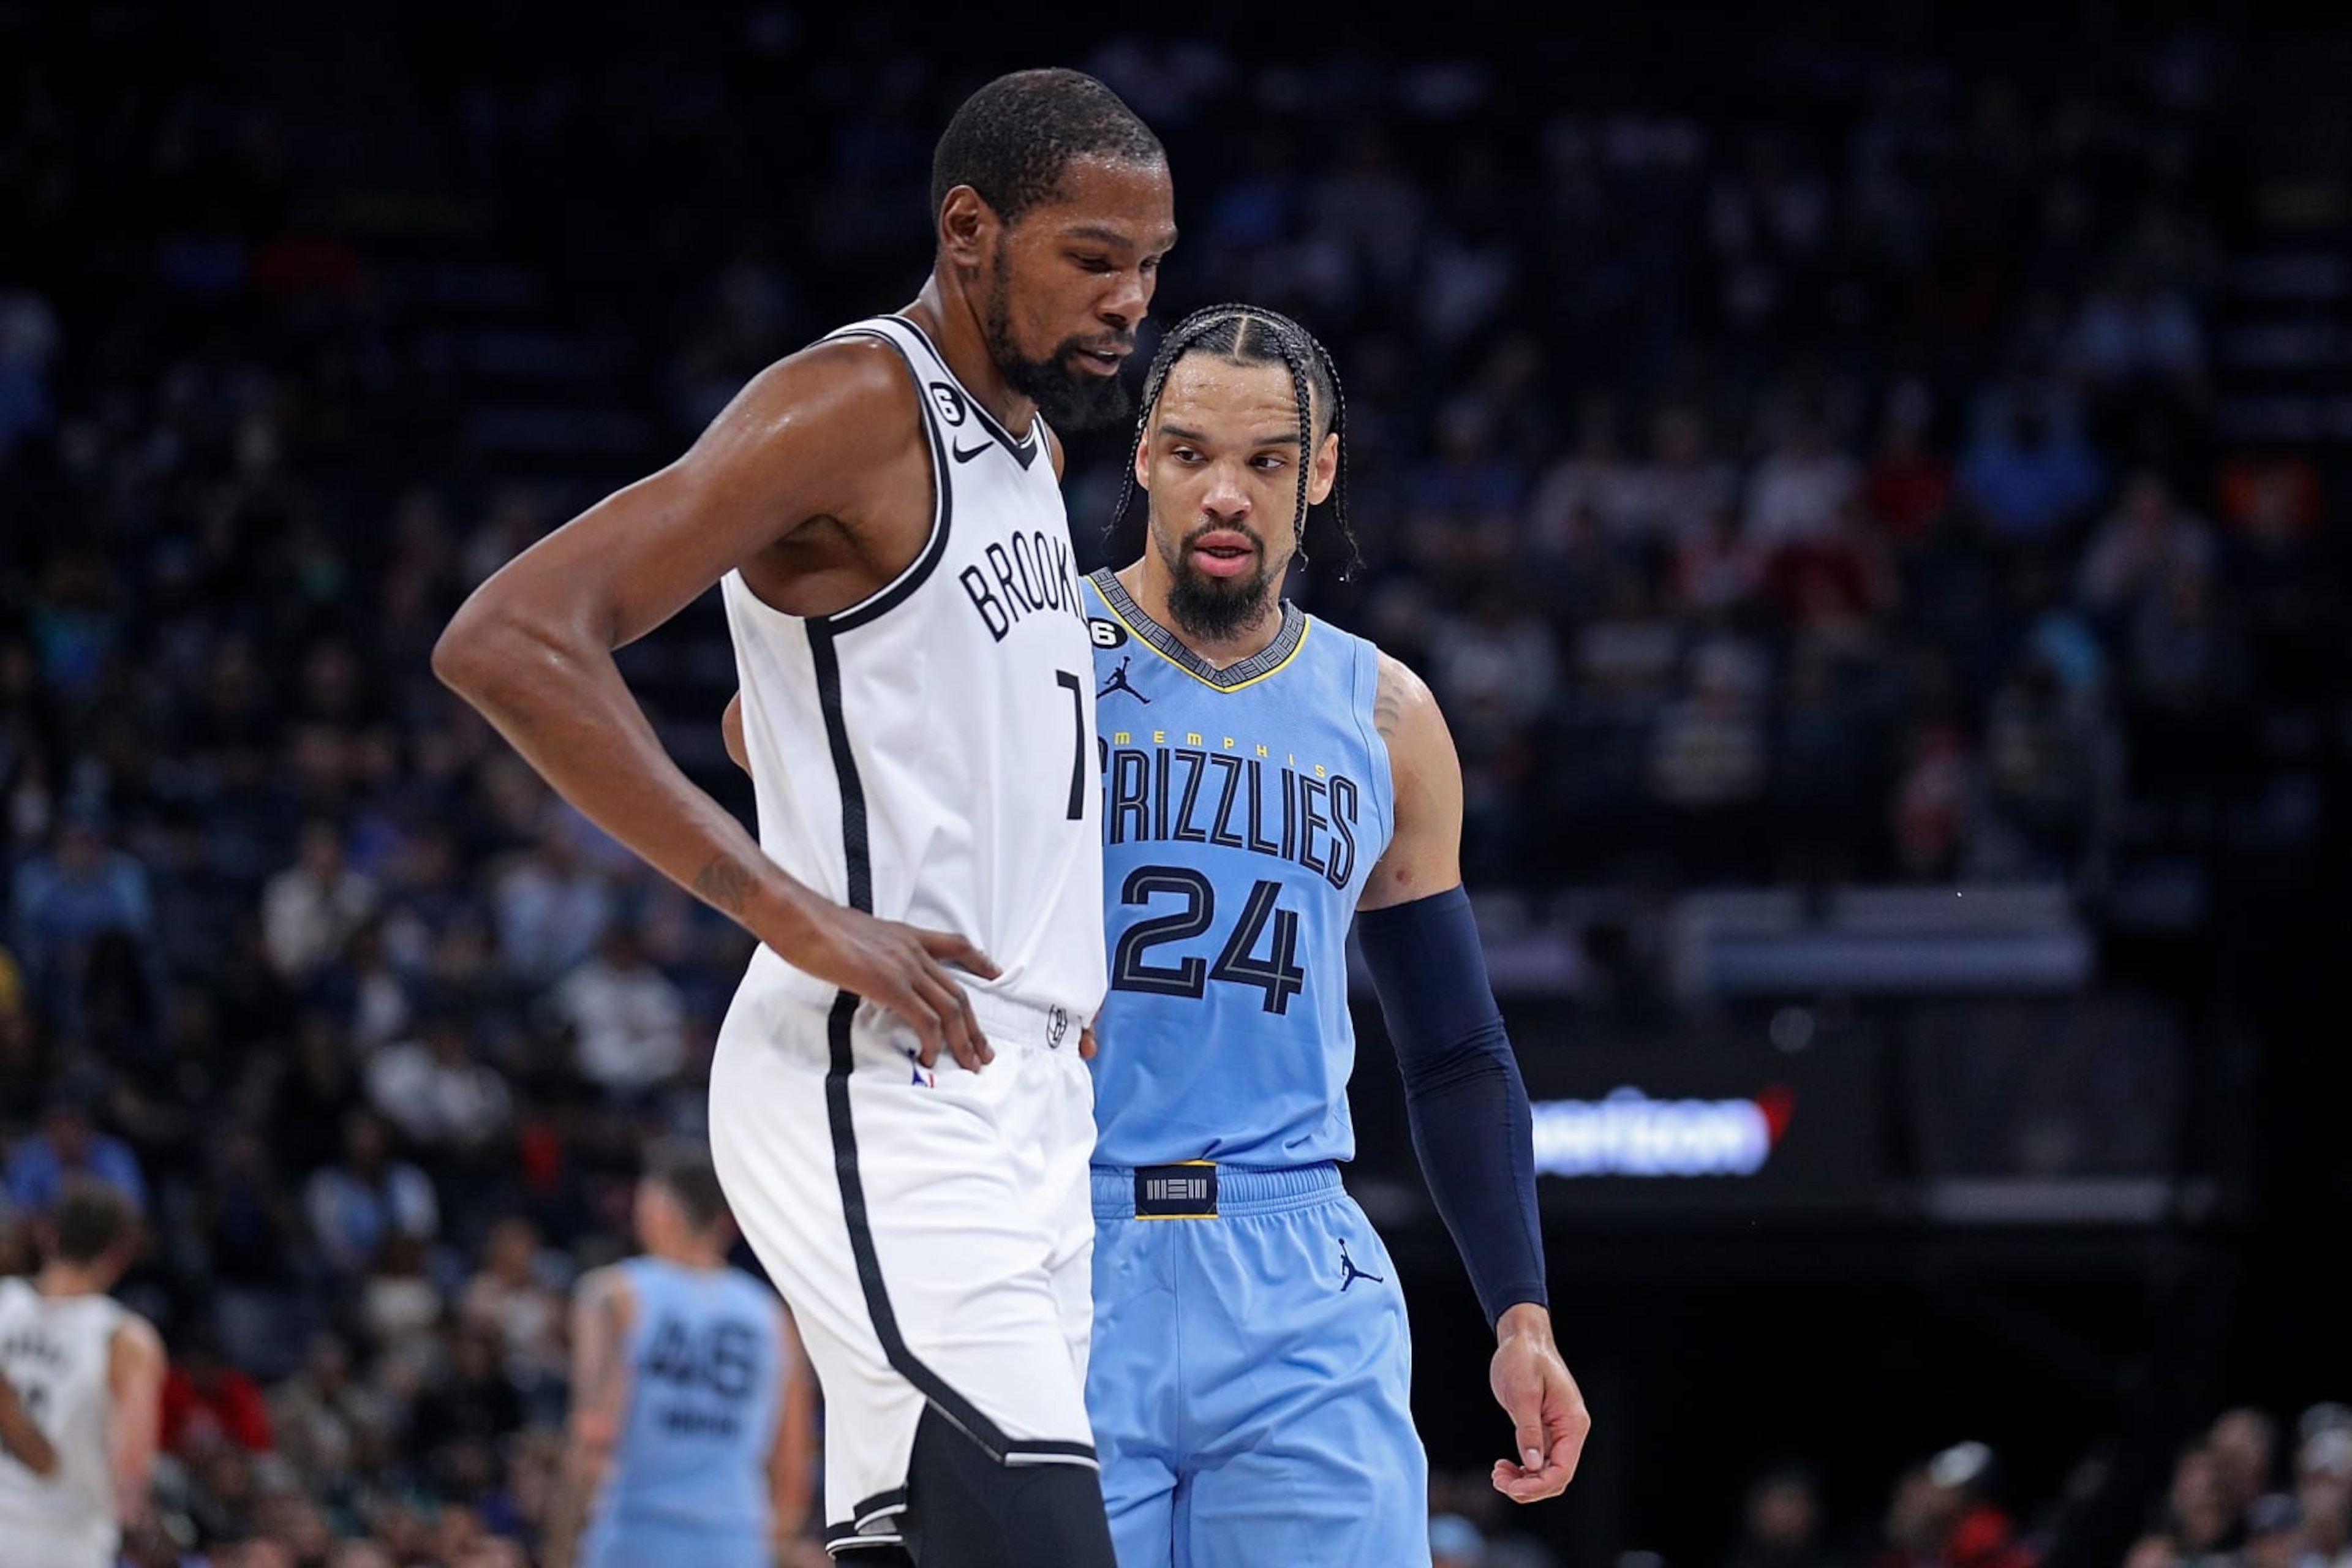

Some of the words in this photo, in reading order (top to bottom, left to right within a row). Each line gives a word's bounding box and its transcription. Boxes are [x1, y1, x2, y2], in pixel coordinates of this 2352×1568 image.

[932, 387, 961, 423] 6
[1091, 622, 1117, 645] 6
[1055, 669, 1085, 820] 7
[1112, 865, 1305, 1015] 24
